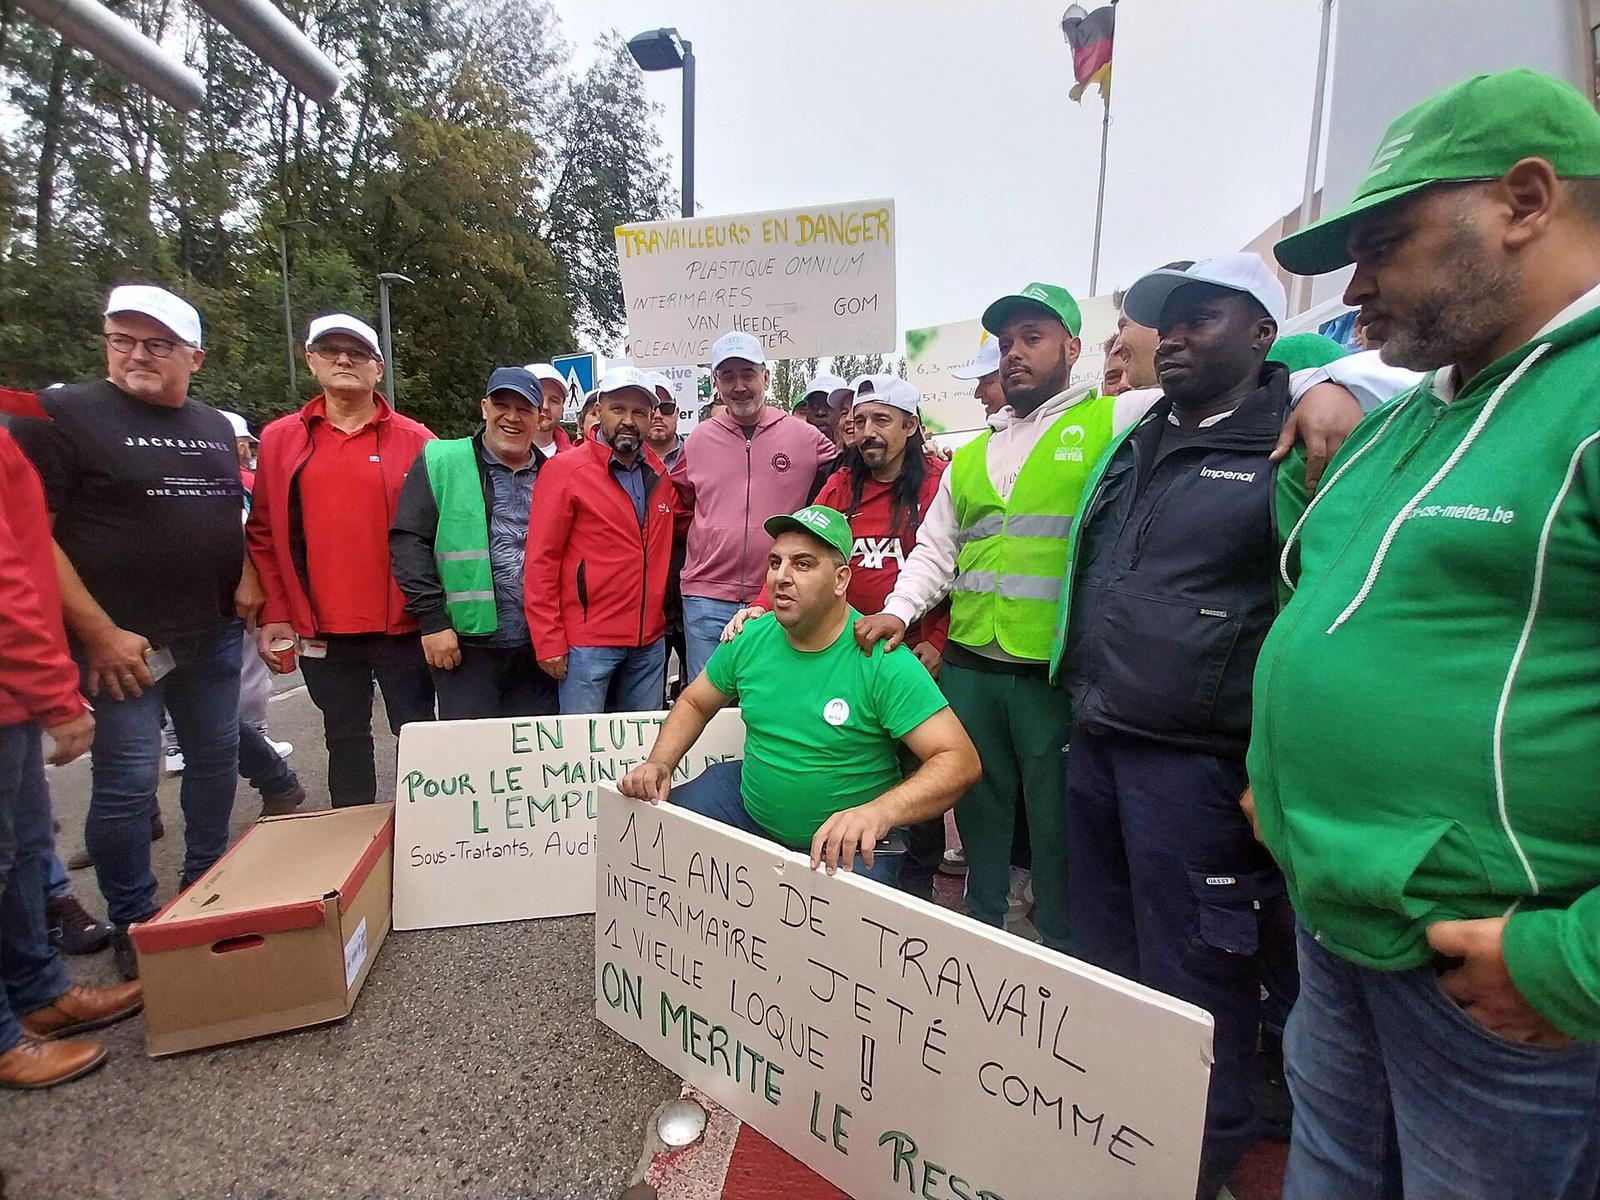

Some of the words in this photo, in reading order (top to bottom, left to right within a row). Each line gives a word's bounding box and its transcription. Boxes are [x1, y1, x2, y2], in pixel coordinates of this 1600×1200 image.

[614, 222, 750, 257] TRAVAILLEURS
[763, 217, 788, 243] EN
[795, 208, 890, 247] DANGER
[686, 258, 776, 280] PLASTIQUE
[784, 252, 865, 277] OMNIUM
[632, 286, 753, 310] INTERIMAIRES
[833, 294, 878, 316] GOM
[687, 313, 721, 331] VAN
[733, 315, 783, 333] HEEDE
[633, 340, 710, 359] CLEANING
[916, 362, 940, 375] 6,3
[1200, 466, 1256, 483] Imperial
[851, 537, 906, 570] AXA
[512, 719, 563, 754] EN
[402, 770, 476, 803] POUR
[490, 766, 523, 794] LE
[411, 839, 534, 867] Sous-Traitants,
[619, 811, 677, 883] 11
[688, 852, 754, 908] ANS
[779, 883, 830, 937] DE
[604, 918, 622, 950] 1
[730, 979, 829, 1069] LOQUE
[602, 962, 643, 1020] ON
[660, 991, 785, 1106] MERITE
[808, 1090, 853, 1156] LE
[807, 958, 947, 1074] JETÉ
[978, 1061, 1155, 1165] COMME
